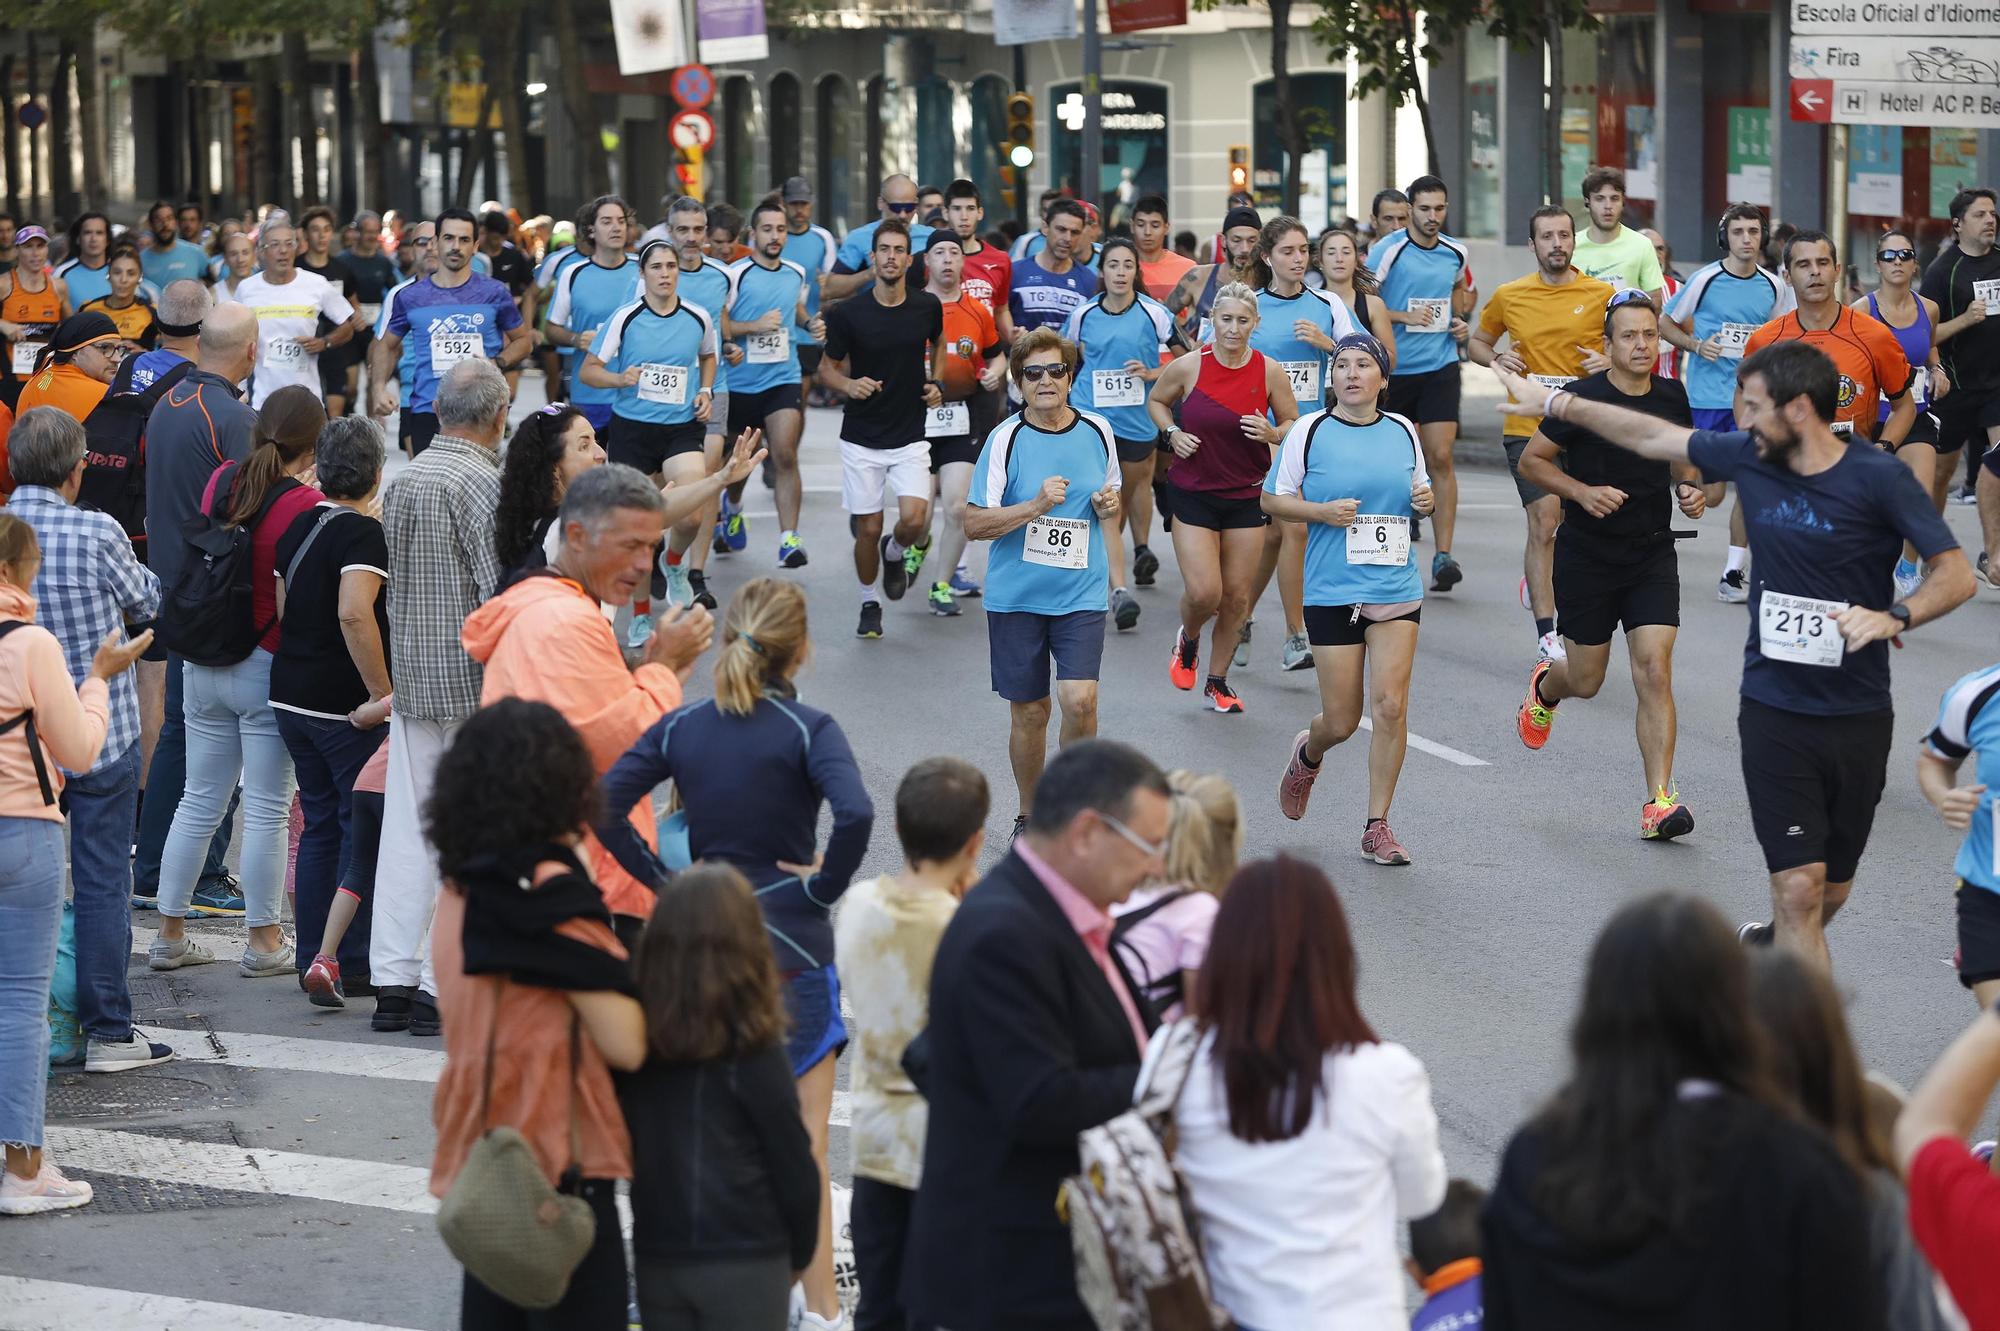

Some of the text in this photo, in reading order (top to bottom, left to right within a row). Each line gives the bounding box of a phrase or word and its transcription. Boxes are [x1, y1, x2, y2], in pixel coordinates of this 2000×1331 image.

[1797, 3, 1856, 22] Escola
[1862, 3, 1918, 23] Oficial
[1826, 47, 1861, 67] Fira
[1847, 95, 1860, 109] H
[1879, 92, 1924, 112] Hotel
[1932, 94, 1957, 114] AC
[1962, 96, 1975, 114] P.
[444, 340, 471, 354] 592
[758, 335, 781, 349] 542
[277, 344, 301, 357] 159
[651, 372, 678, 388] 383
[1105, 377, 1133, 390] 615
[936, 408, 954, 421] 69
[1047, 528, 1073, 548] 86
[1375, 525, 1387, 544] 6
[1027, 547, 1058, 557] montepio
[1350, 547, 1381, 555] montepio
[1775, 609, 1823, 637] 213
